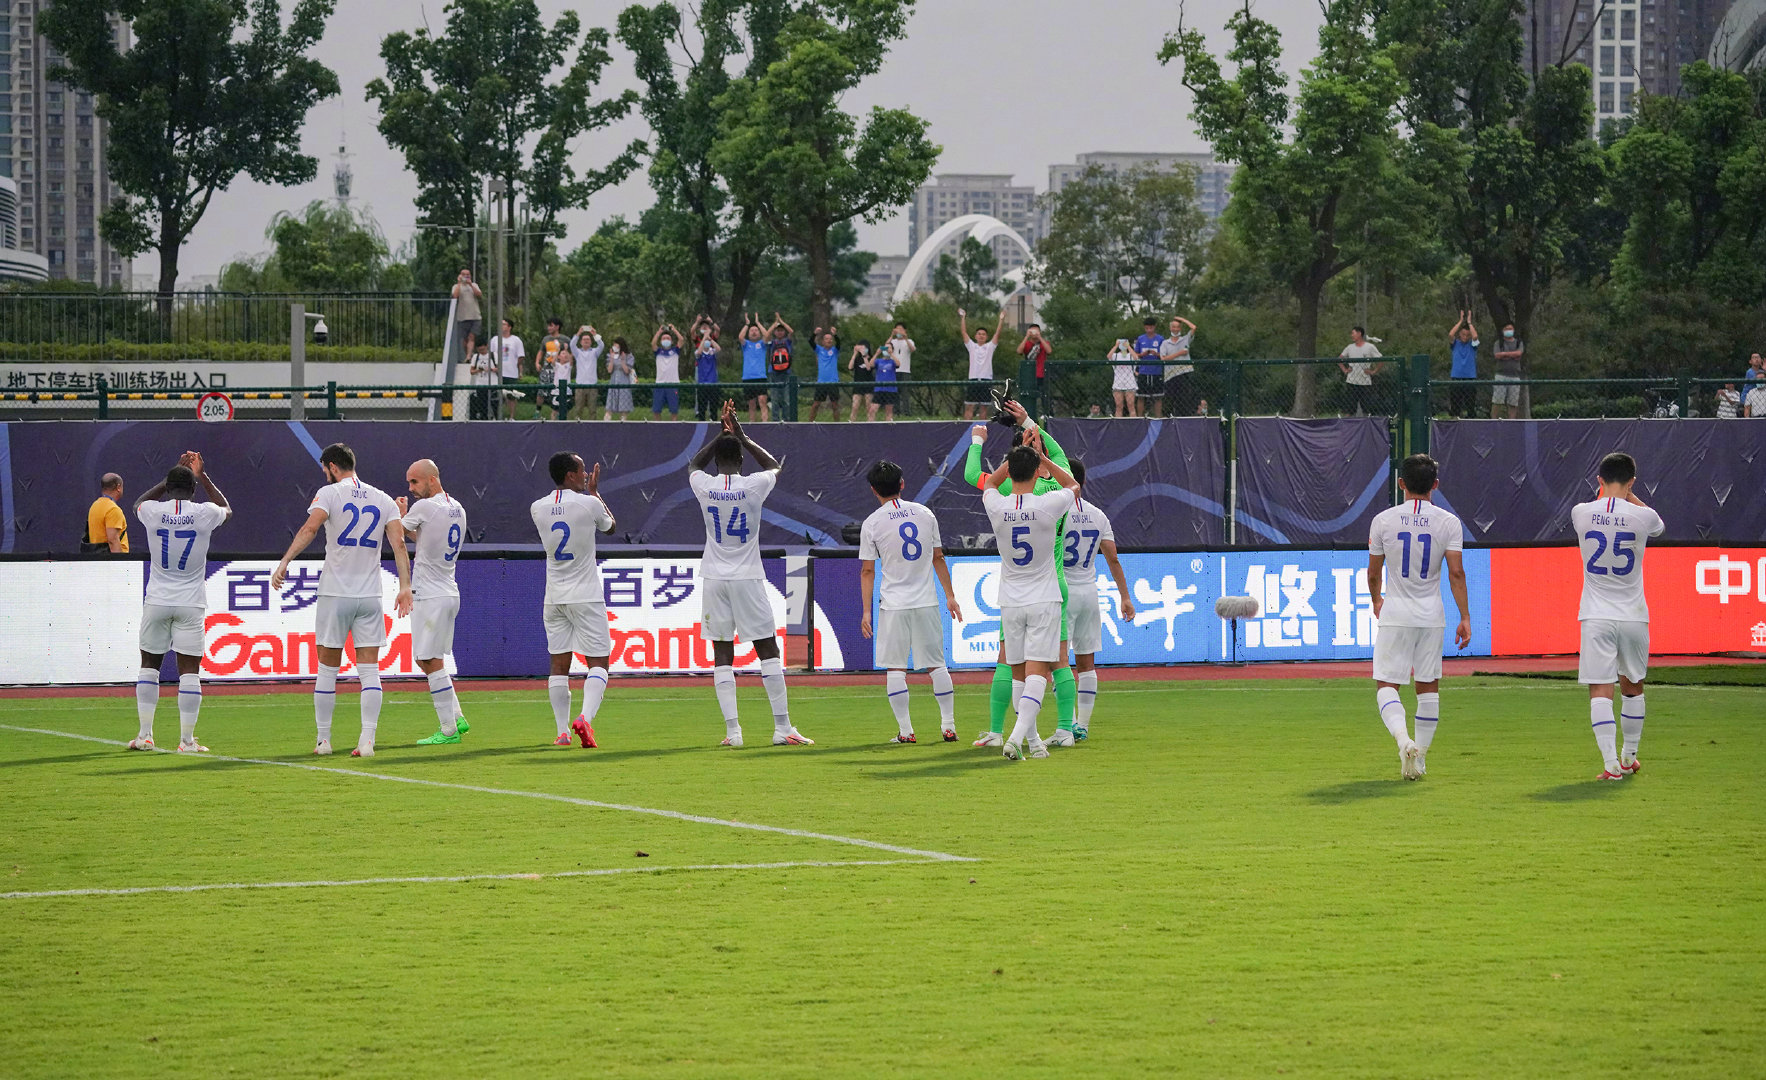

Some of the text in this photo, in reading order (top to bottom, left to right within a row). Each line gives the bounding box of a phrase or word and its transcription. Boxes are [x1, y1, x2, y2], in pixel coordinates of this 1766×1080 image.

[551, 506, 565, 516] AIDI
[709, 491, 746, 501] DOUMBOUYA
[888, 510, 908, 520] ZHANG
[161, 513, 195, 525] BASSOGOG
[337, 502, 380, 548] 22
[707, 506, 750, 543] 14
[1003, 512, 1016, 522] ZHU
[1400, 515, 1410, 526] YU
[1591, 513, 1611, 526] PENG
[156, 528, 197, 570] 17
[445, 523, 461, 562] 9
[551, 521, 575, 561] 2
[899, 521, 923, 561] 8
[1011, 526, 1034, 566] 5
[1063, 529, 1100, 568] 37
[1397, 531, 1432, 579] 11
[1584, 530, 1636, 576] 25
[601, 565, 695, 609] 百岁
[1695, 554, 1766, 605] 中
[969, 641, 1000, 652] MEN
